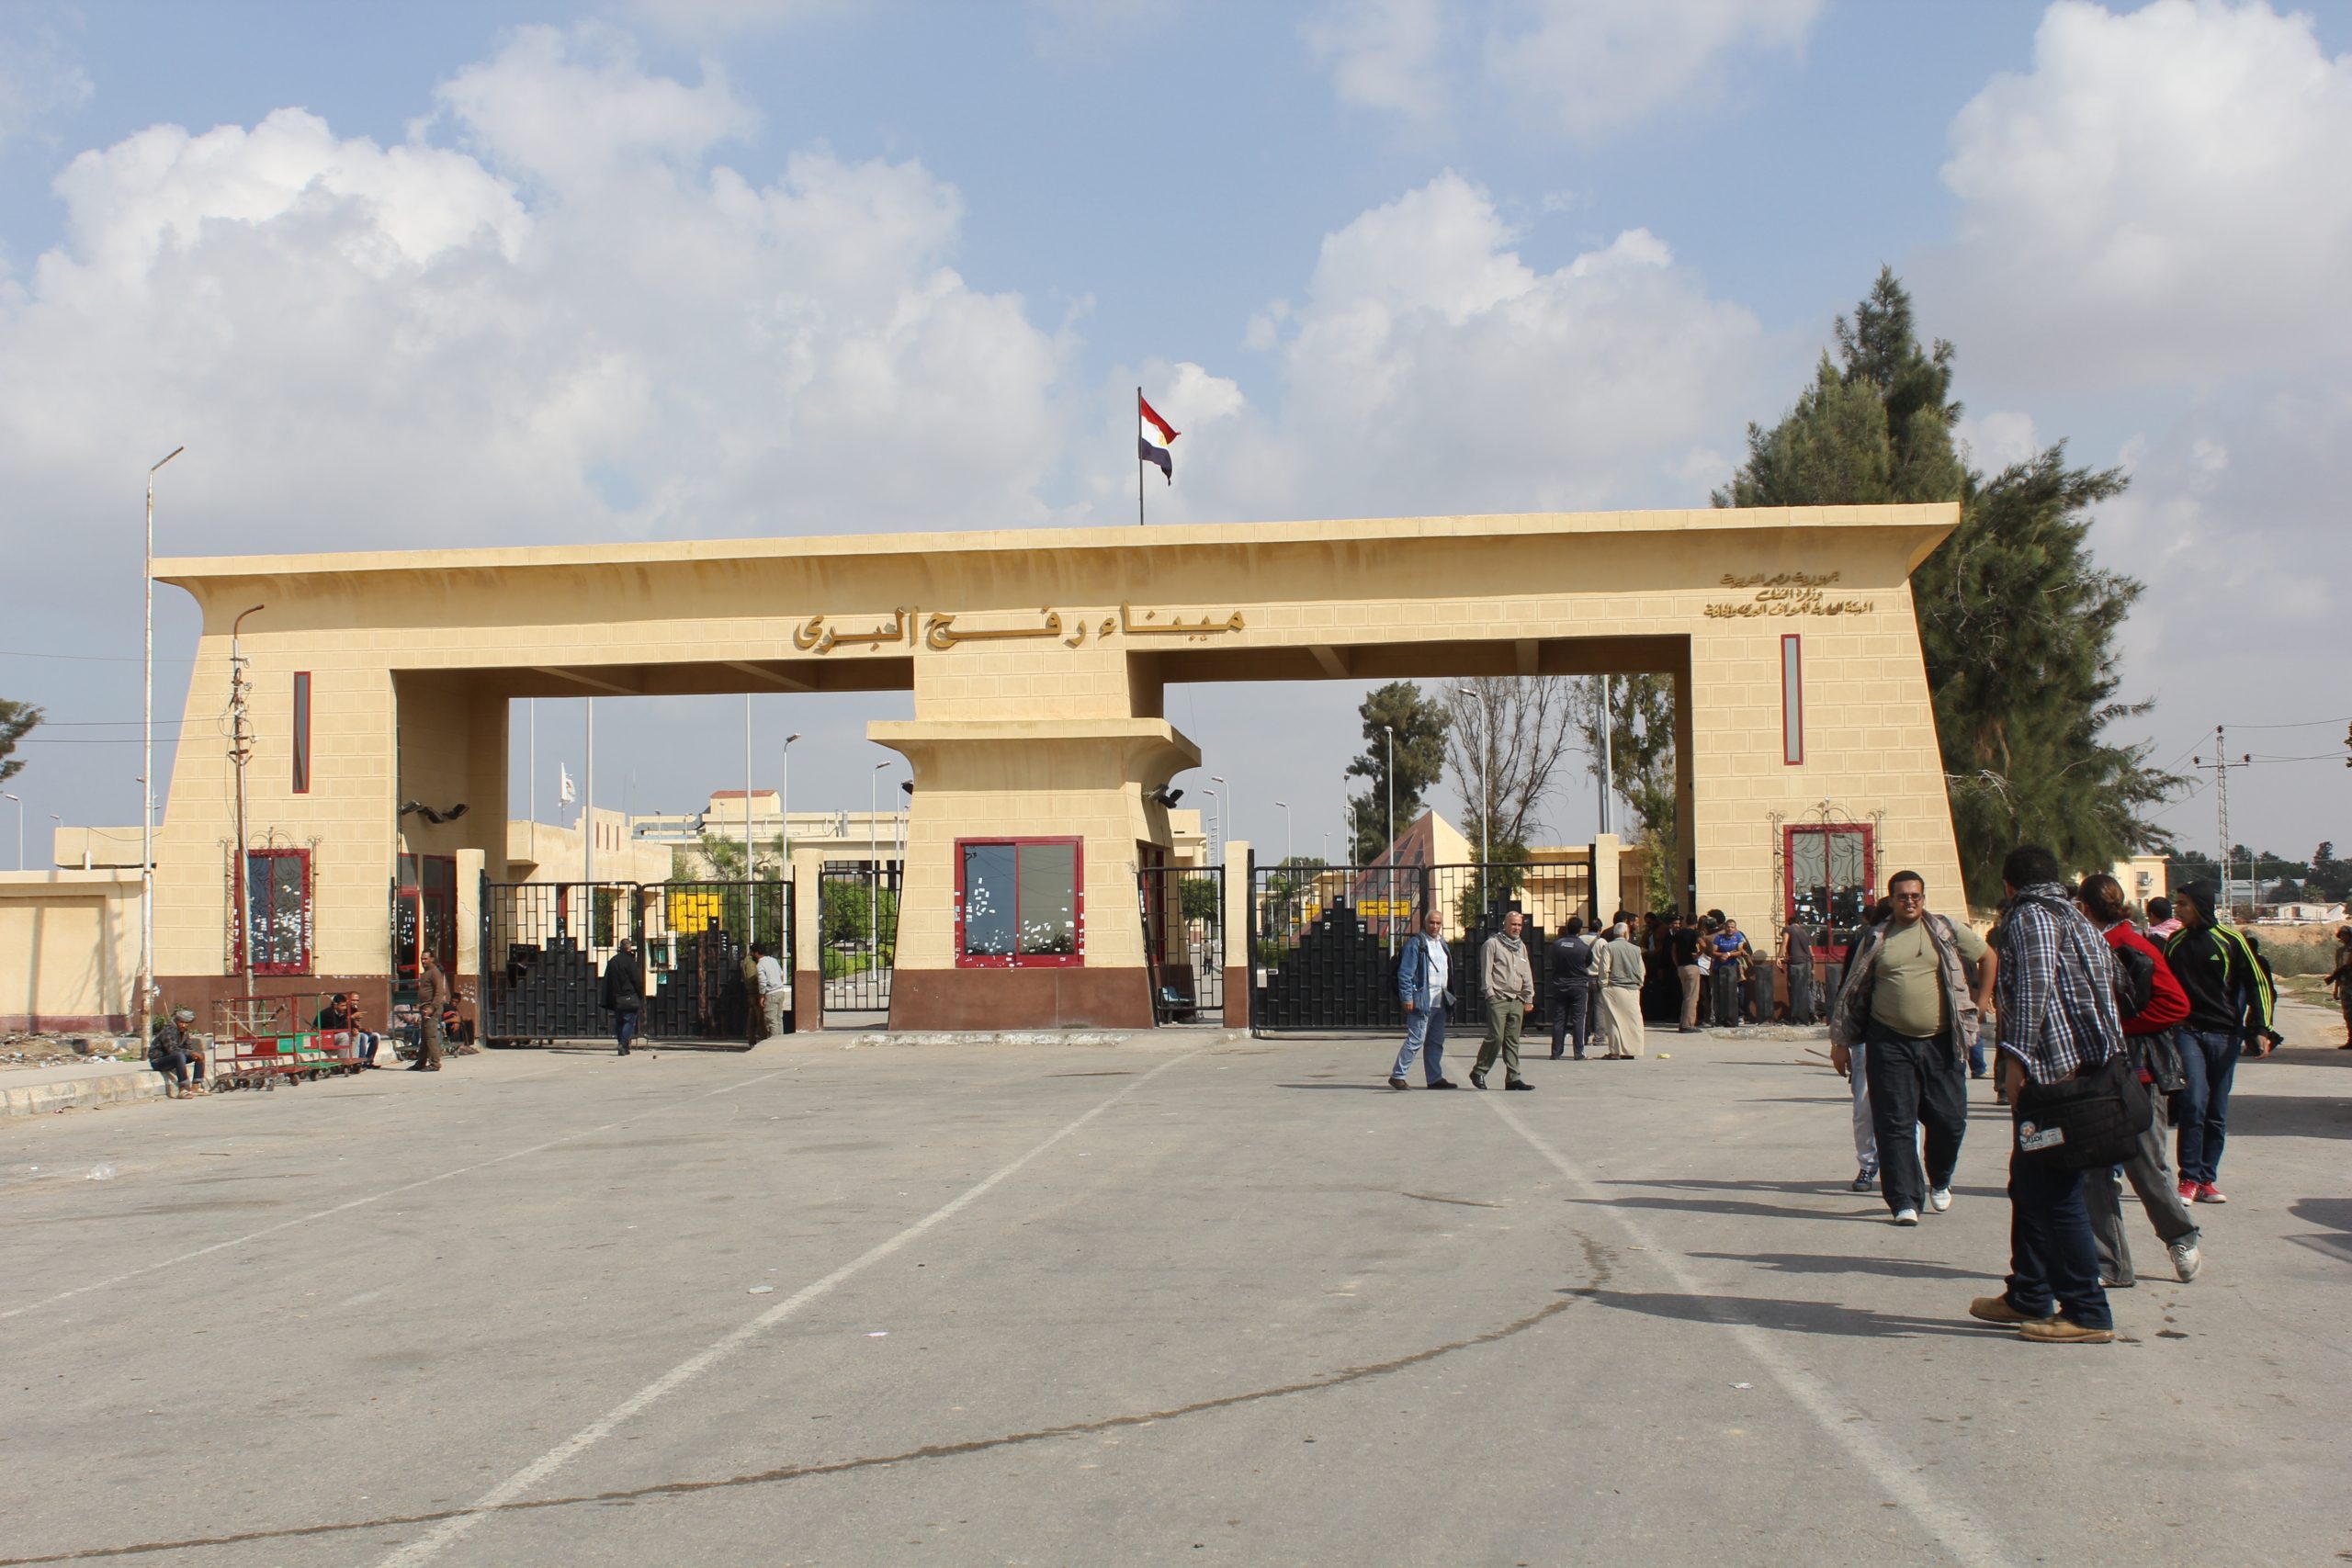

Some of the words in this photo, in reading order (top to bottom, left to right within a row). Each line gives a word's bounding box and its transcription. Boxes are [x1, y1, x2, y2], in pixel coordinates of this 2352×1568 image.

[1720, 572, 1765, 588] العربية
[1763, 572, 1792, 586] مصر
[1792, 570, 1840, 585] جمهورية
[1794, 588, 1823, 602] وزارة
[926, 604, 1088, 649] رفح
[1098, 600, 1246, 643] ميناء
